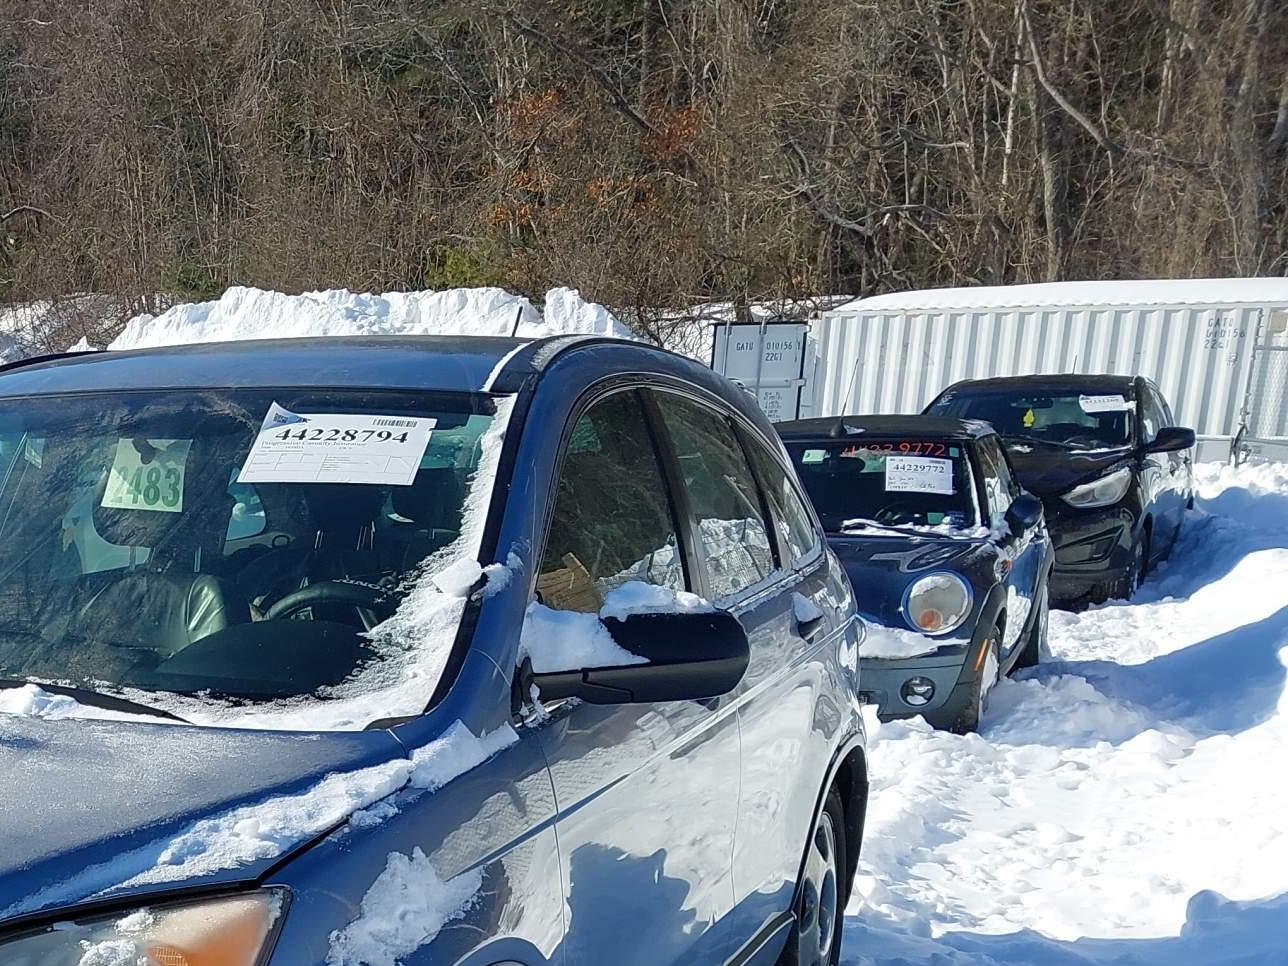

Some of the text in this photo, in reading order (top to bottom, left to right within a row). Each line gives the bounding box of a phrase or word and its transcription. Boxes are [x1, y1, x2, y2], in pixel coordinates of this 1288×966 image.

[736, 342, 754, 351] GATU
[766, 342, 793, 350] 010156
[275, 428, 411, 443] 44228794
[893, 464, 945, 473] 44229772
